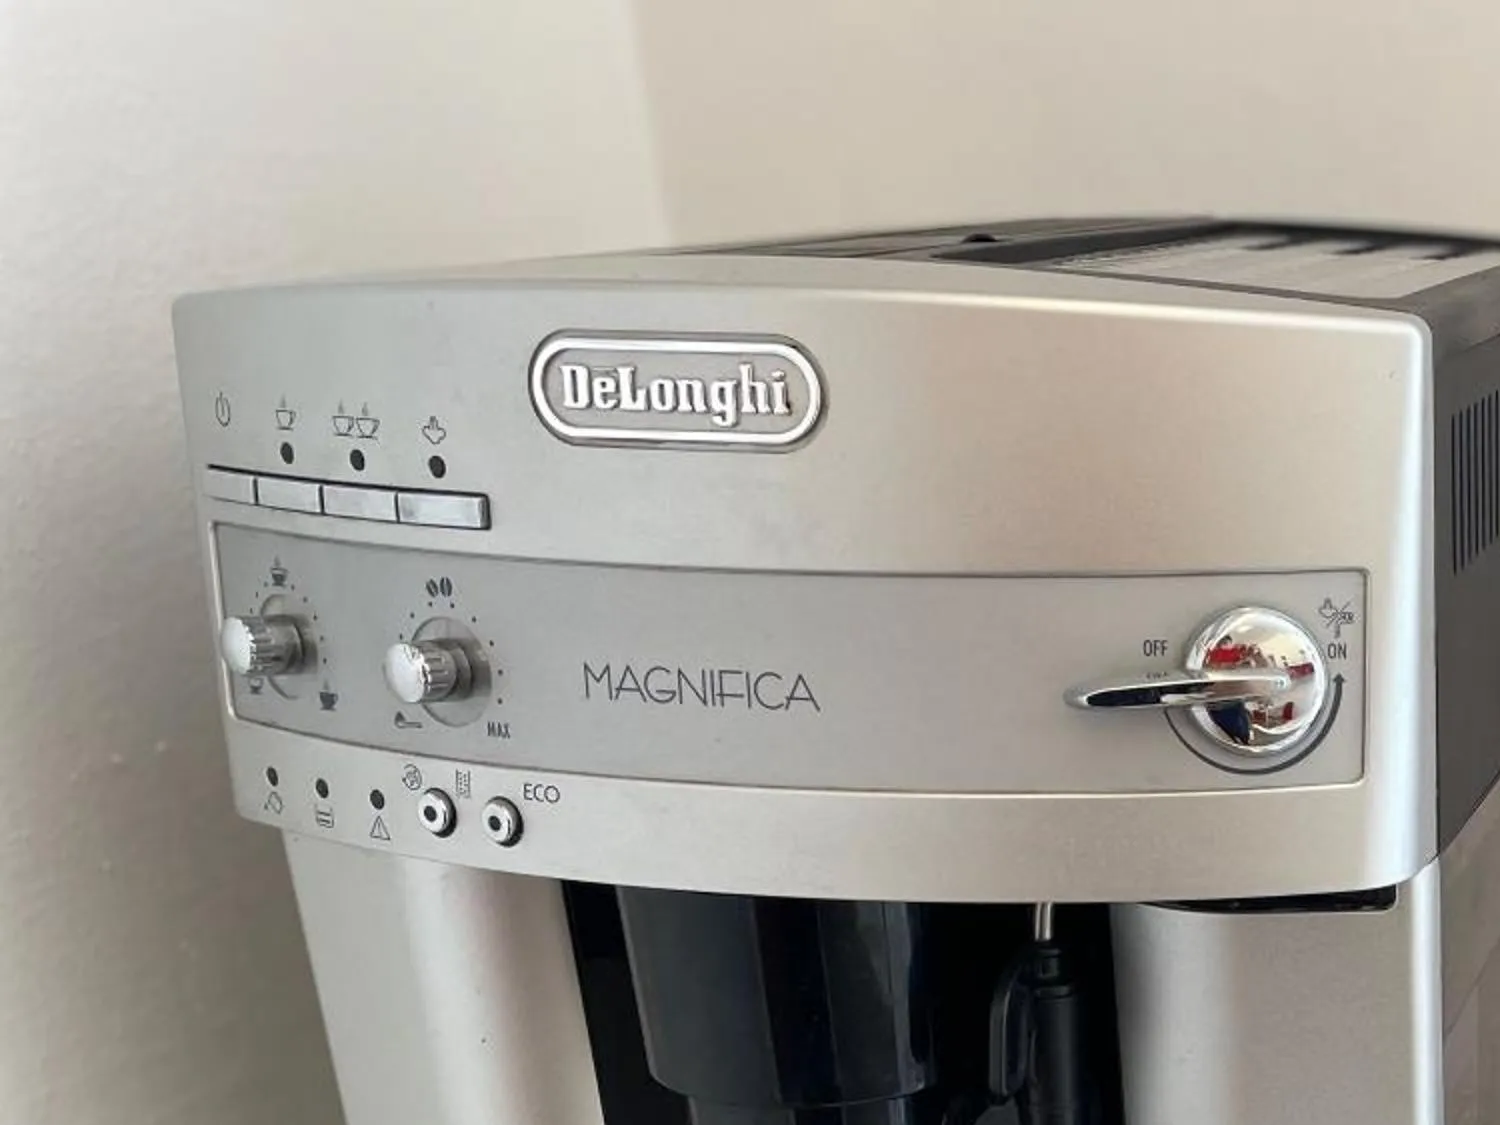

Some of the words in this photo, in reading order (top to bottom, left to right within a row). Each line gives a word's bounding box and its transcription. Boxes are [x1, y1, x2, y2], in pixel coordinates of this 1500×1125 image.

[1142, 639, 1169, 657] OFF
[1327, 643, 1348, 660] ON
[583, 661, 821, 712] MAGNIFICA
[486, 721, 511, 739] MAX
[523, 783, 561, 804] ECO
